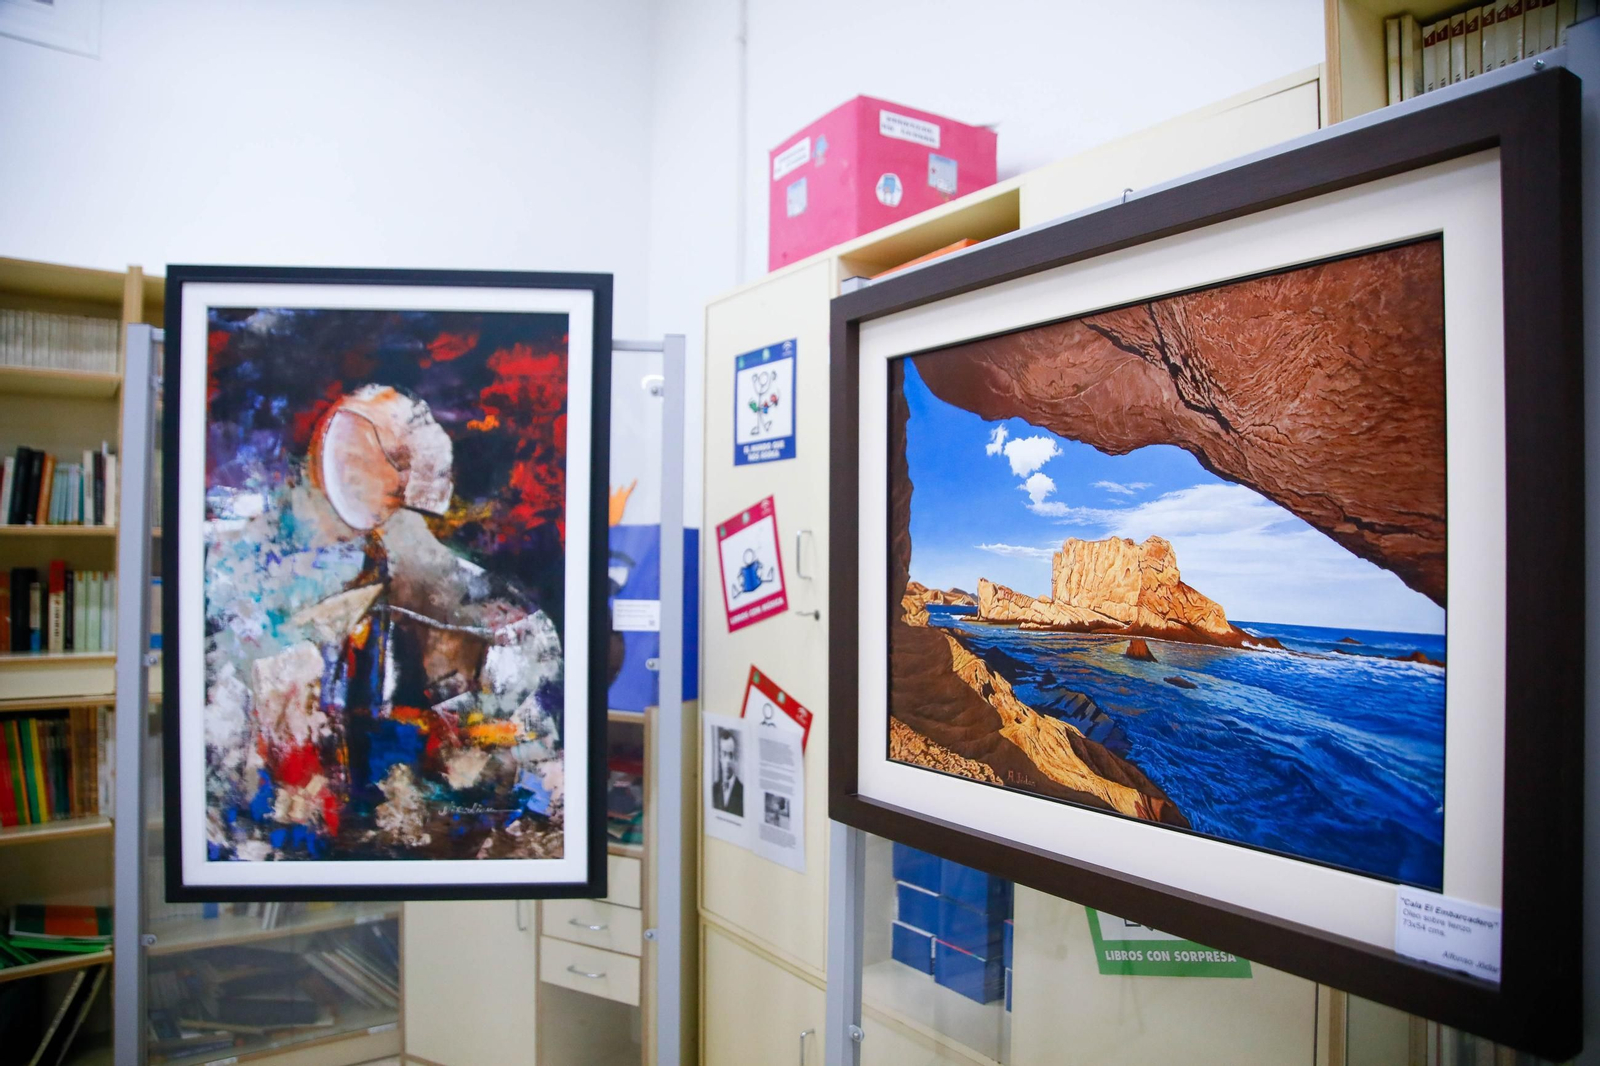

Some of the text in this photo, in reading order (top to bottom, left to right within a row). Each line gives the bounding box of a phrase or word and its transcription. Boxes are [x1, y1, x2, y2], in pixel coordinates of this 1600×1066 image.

[1424, 904, 1434, 912] El
[1423, 914, 1445, 926] sobre
[1105, 950, 1237, 963] LIBROS CON SORPRESA
